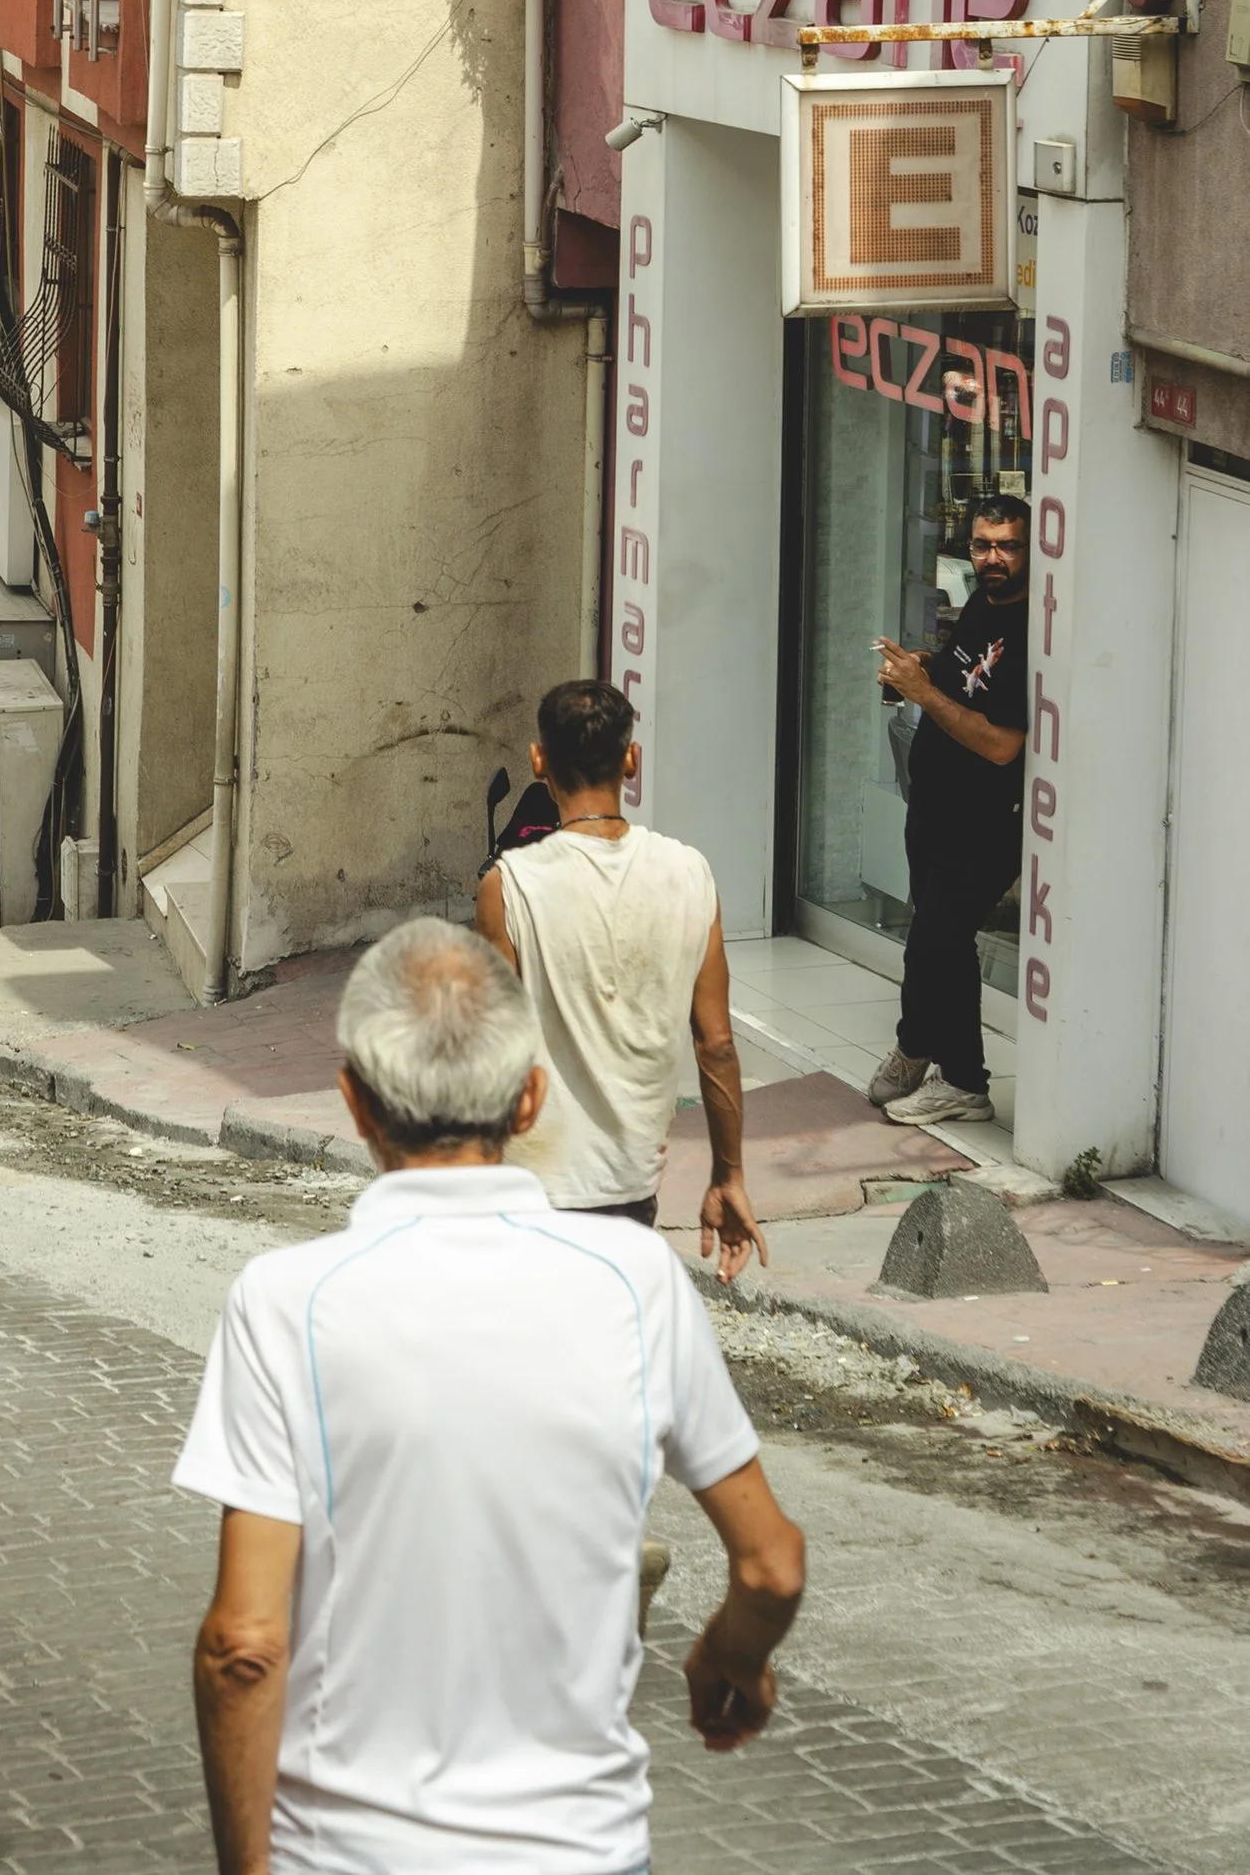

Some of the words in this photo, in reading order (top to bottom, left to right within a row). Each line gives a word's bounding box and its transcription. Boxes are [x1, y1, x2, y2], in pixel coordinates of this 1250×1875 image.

[849, 125, 961, 264] E
[830, 314, 1034, 441] eczan
[1025, 315, 1070, 1022] apotheke
